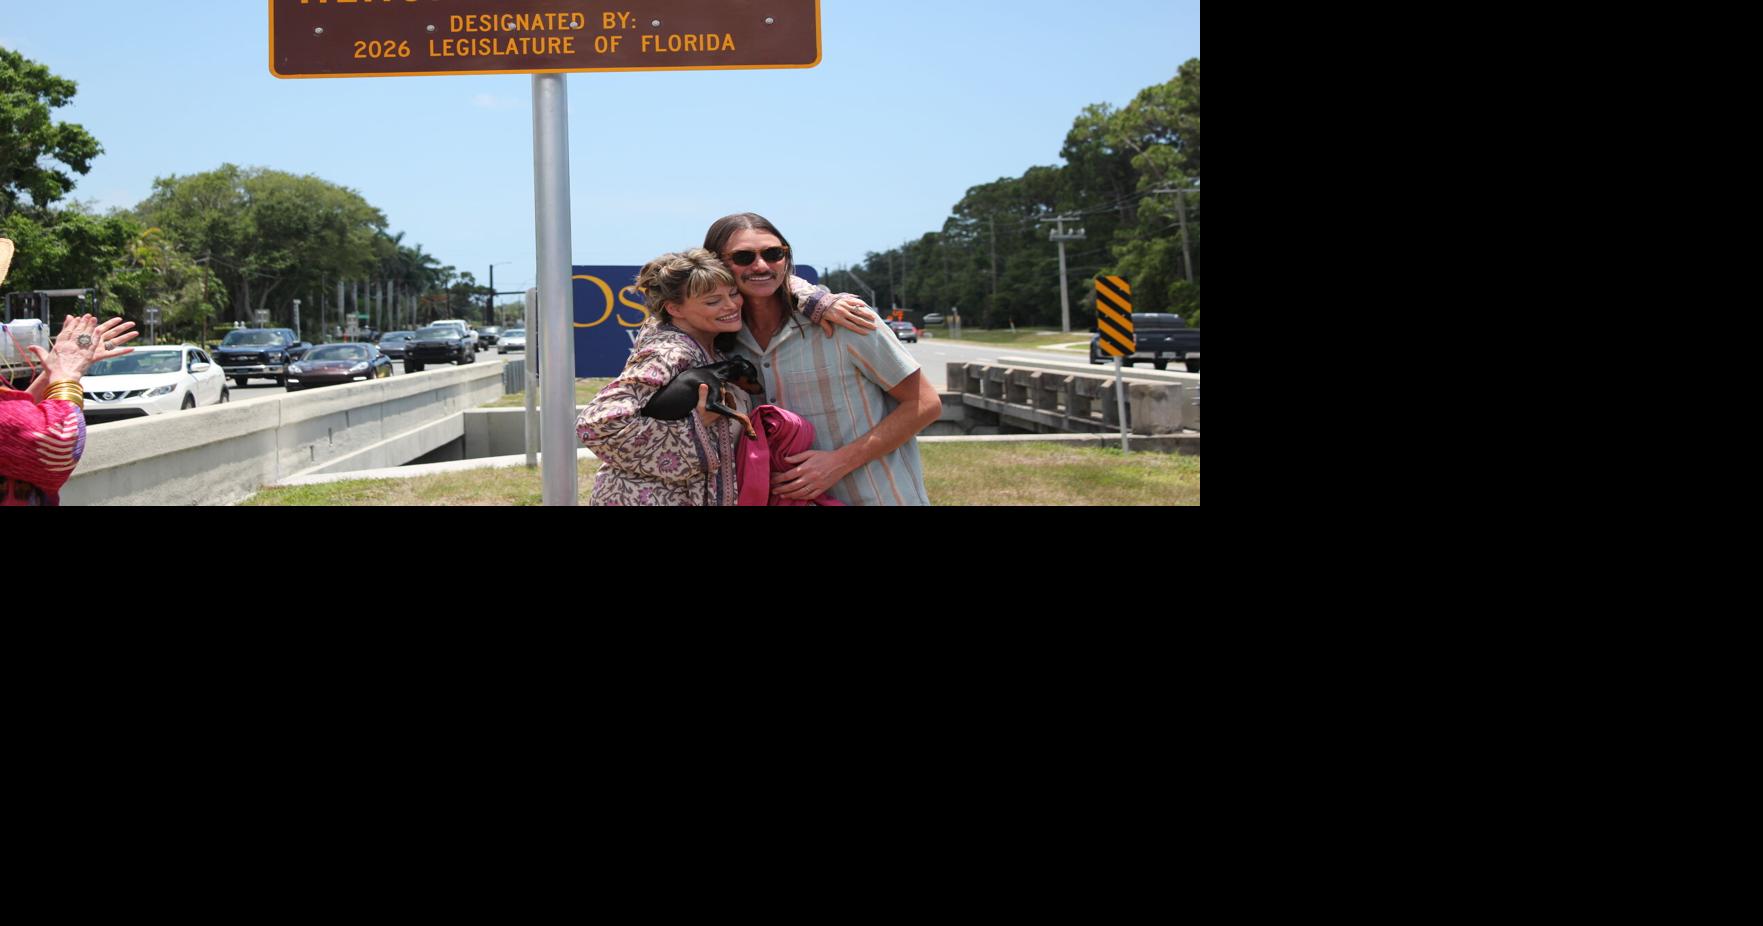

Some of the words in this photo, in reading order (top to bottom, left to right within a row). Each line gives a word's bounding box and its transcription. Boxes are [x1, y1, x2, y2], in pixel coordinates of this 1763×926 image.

[449, 12, 586, 33] DESIGNATED
[602, 11, 638, 30] BY:
[353, 40, 411, 59] 2026
[428, 36, 576, 57] LEGISLATURE
[594, 35, 623, 55] OF
[640, 33, 736, 53] FLORIDA
